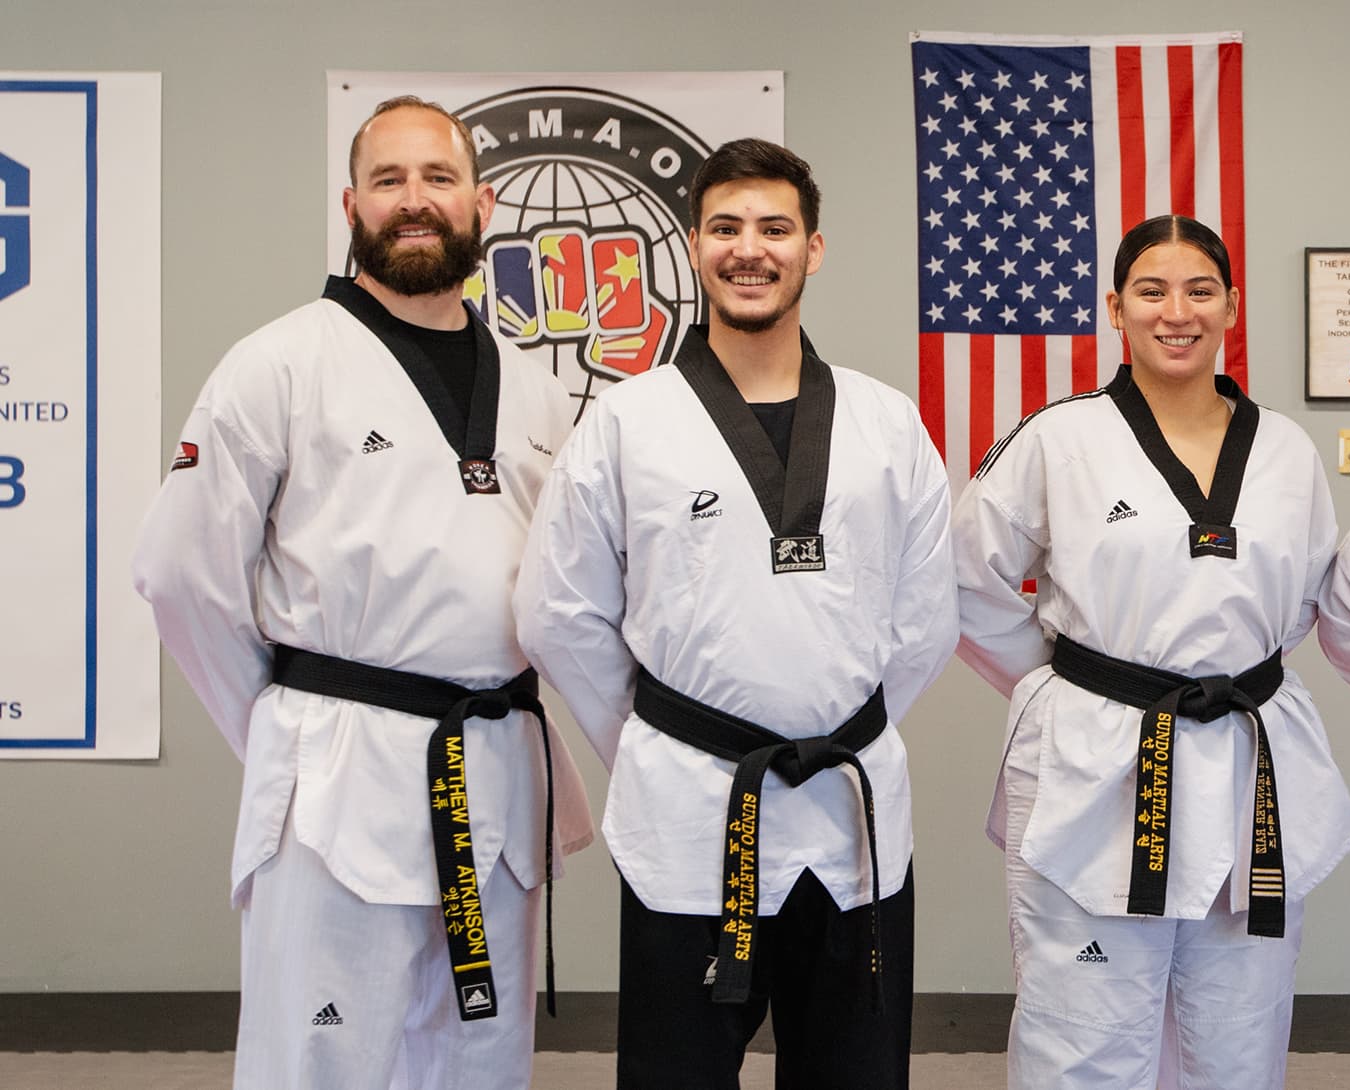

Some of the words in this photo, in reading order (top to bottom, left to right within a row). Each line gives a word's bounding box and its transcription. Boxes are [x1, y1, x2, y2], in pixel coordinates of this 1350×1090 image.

[1319, 260, 1338, 268] THE
[1106, 509, 1139, 524] adidas
[776, 538, 821, 563] 武道
[1153, 711, 1172, 762] SUNDO
[446, 736, 470, 824] MATTHEW
[1152, 763, 1169, 830] MARTIAL
[740, 792, 757, 846] SUNDO
[453, 832, 473, 853] M.
[1149, 833, 1165, 872] ARTS
[738, 848, 755, 917] MARTIAL
[457, 865, 487, 956] ATKINSON
[735, 919, 752, 962] ARTS
[1076, 954, 1109, 963] adidas
[311, 1015, 344, 1025] adidas
